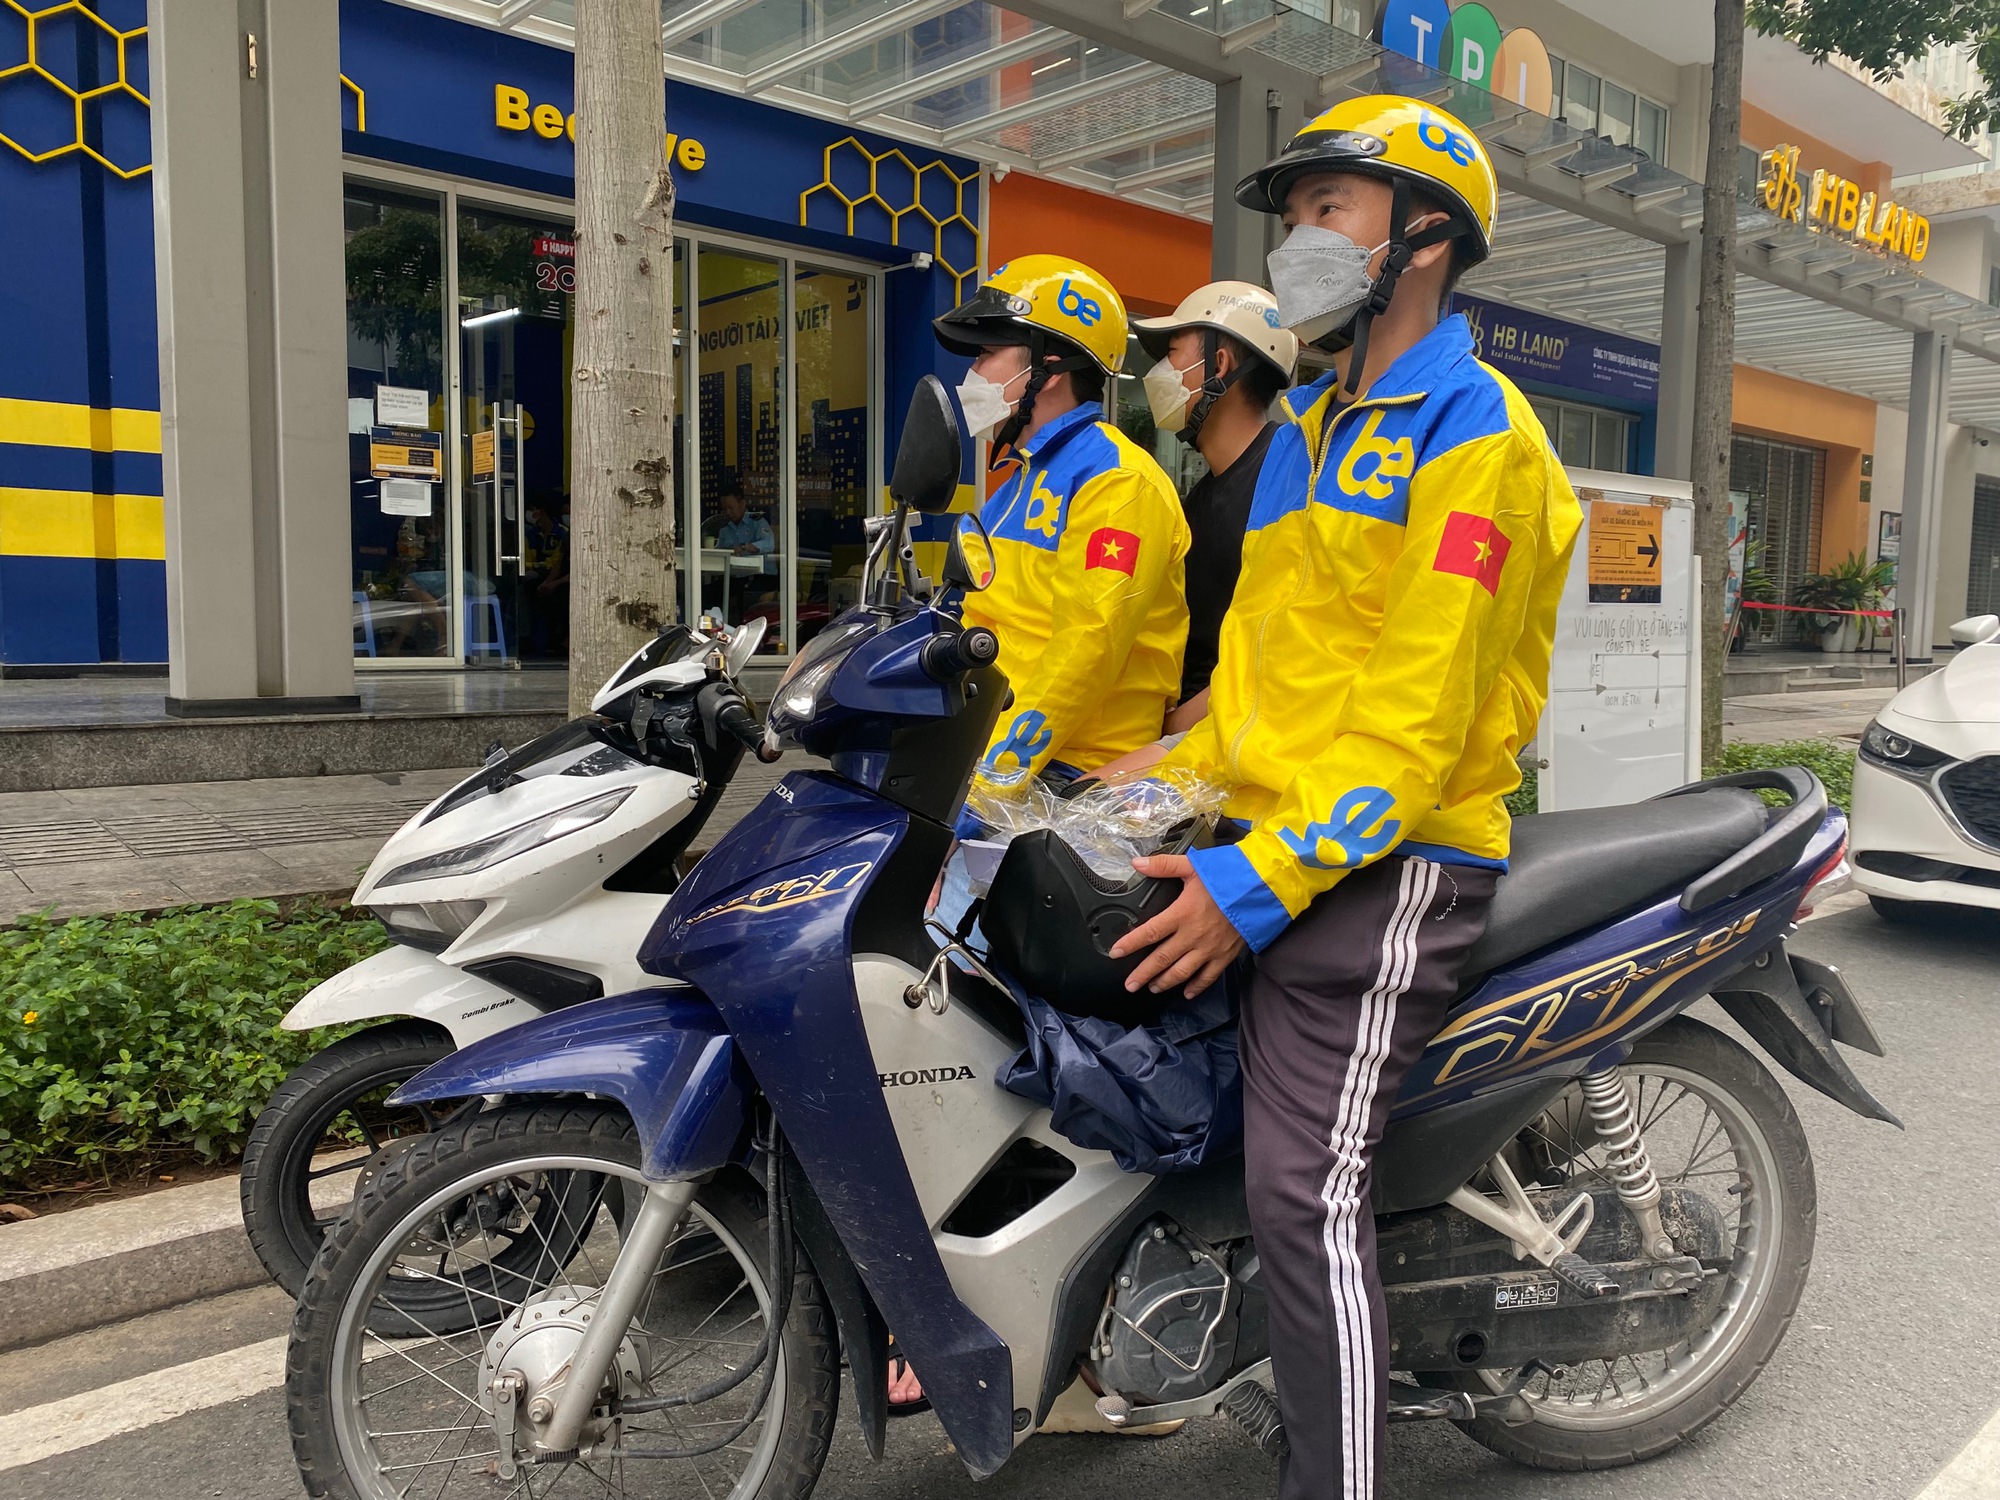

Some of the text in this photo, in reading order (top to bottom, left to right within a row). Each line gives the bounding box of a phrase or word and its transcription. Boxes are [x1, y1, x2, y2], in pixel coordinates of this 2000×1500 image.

[1418, 108, 1476, 167] be
[1815, 169, 1931, 262] HB LAND
[549, 242, 575, 256] HAPPY
[1058, 279, 1101, 326] be
[1217, 294, 1264, 315] PIAGGIO
[699, 322, 743, 353] NGƯỜI
[746, 315, 770, 342] TÀI
[795, 301, 831, 334] VIỆT
[1492, 323, 1517, 350] HB
[1491, 349, 1503, 359] Real
[1504, 352, 1521, 364] Estate
[1529, 358, 1561, 371] Management
[1337, 408, 1415, 499] be
[1574, 617, 1592, 638] VUI
[1637, 619, 1648, 637] XE
[1625, 640, 1635, 653] TY
[1640, 639, 1651, 652] BE
[461, 998, 515, 1019] Combi Brake
[878, 1066, 976, 1087] HONDA
